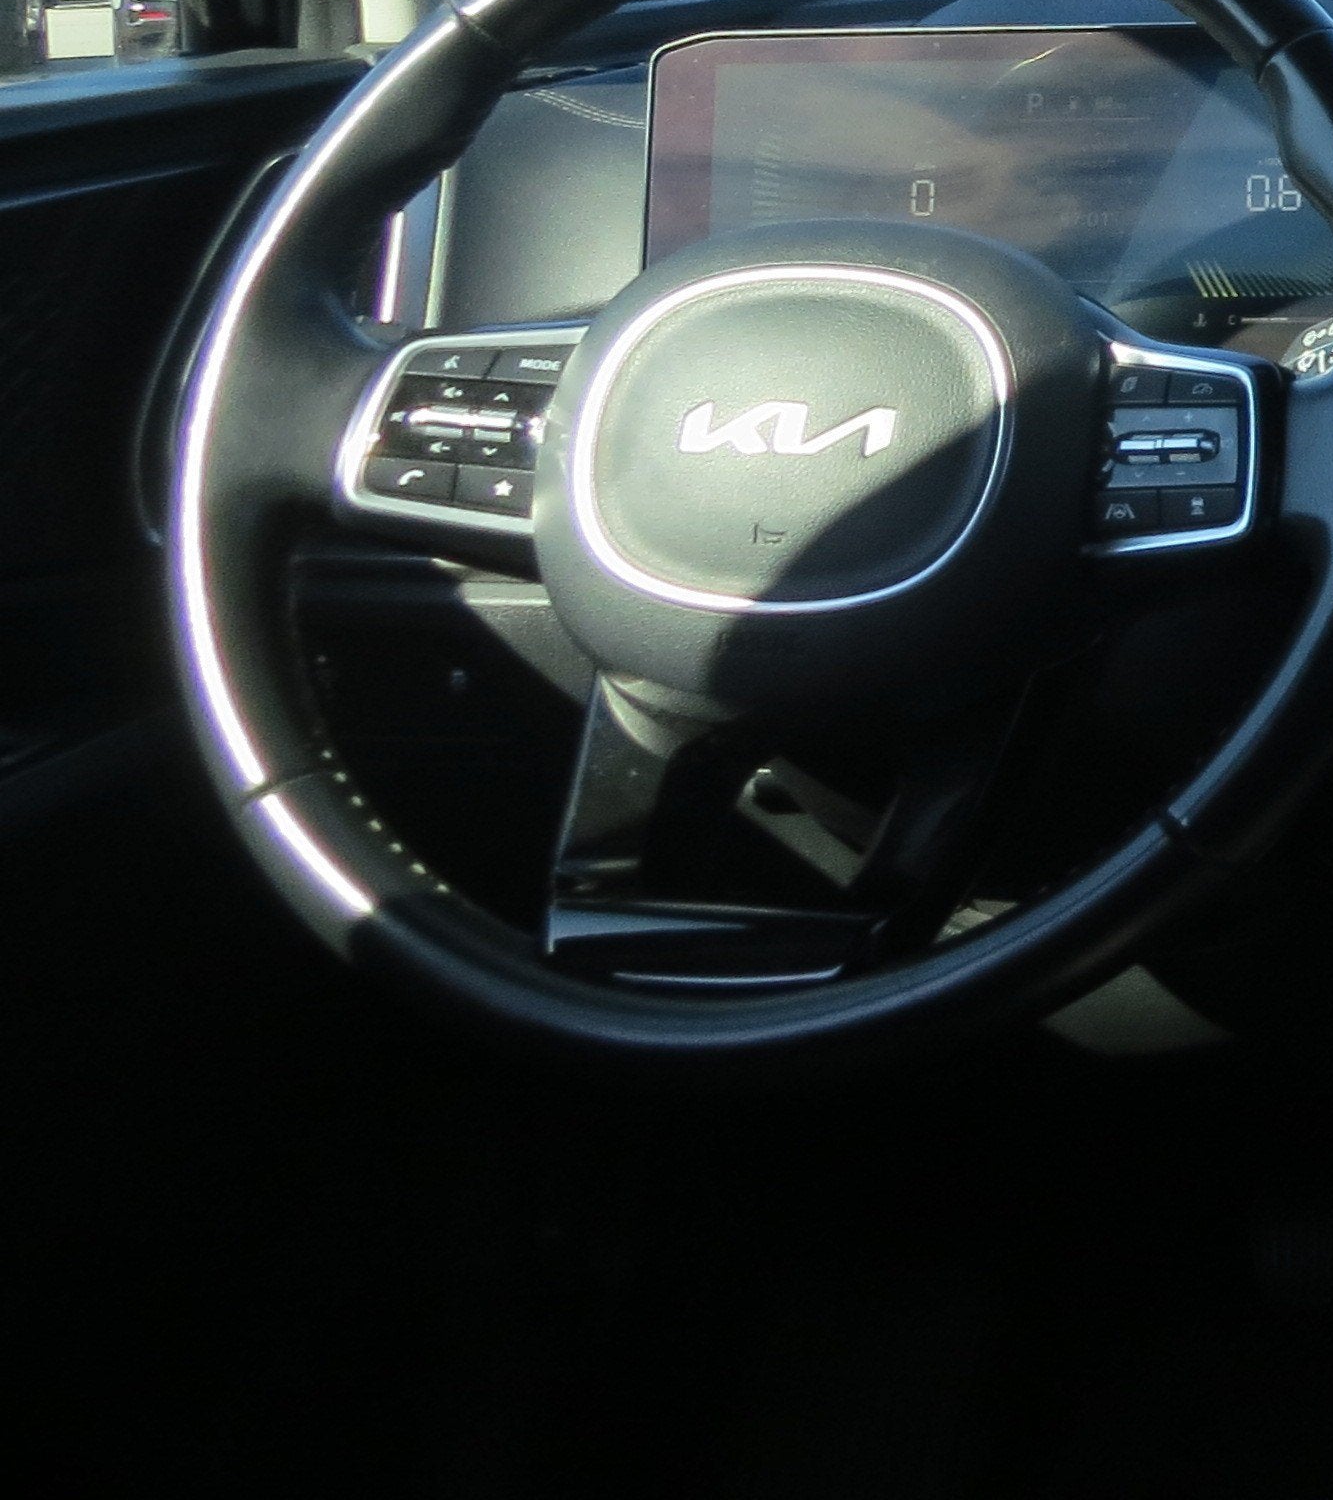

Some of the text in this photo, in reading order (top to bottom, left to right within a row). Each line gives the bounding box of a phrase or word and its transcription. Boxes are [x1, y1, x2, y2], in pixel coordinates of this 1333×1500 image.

[911, 179, 935, 217] 0
[1246, 174, 1302, 213] 0.6
[519, 359, 561, 372] MODE
[677, 399, 898, 459] KIA
